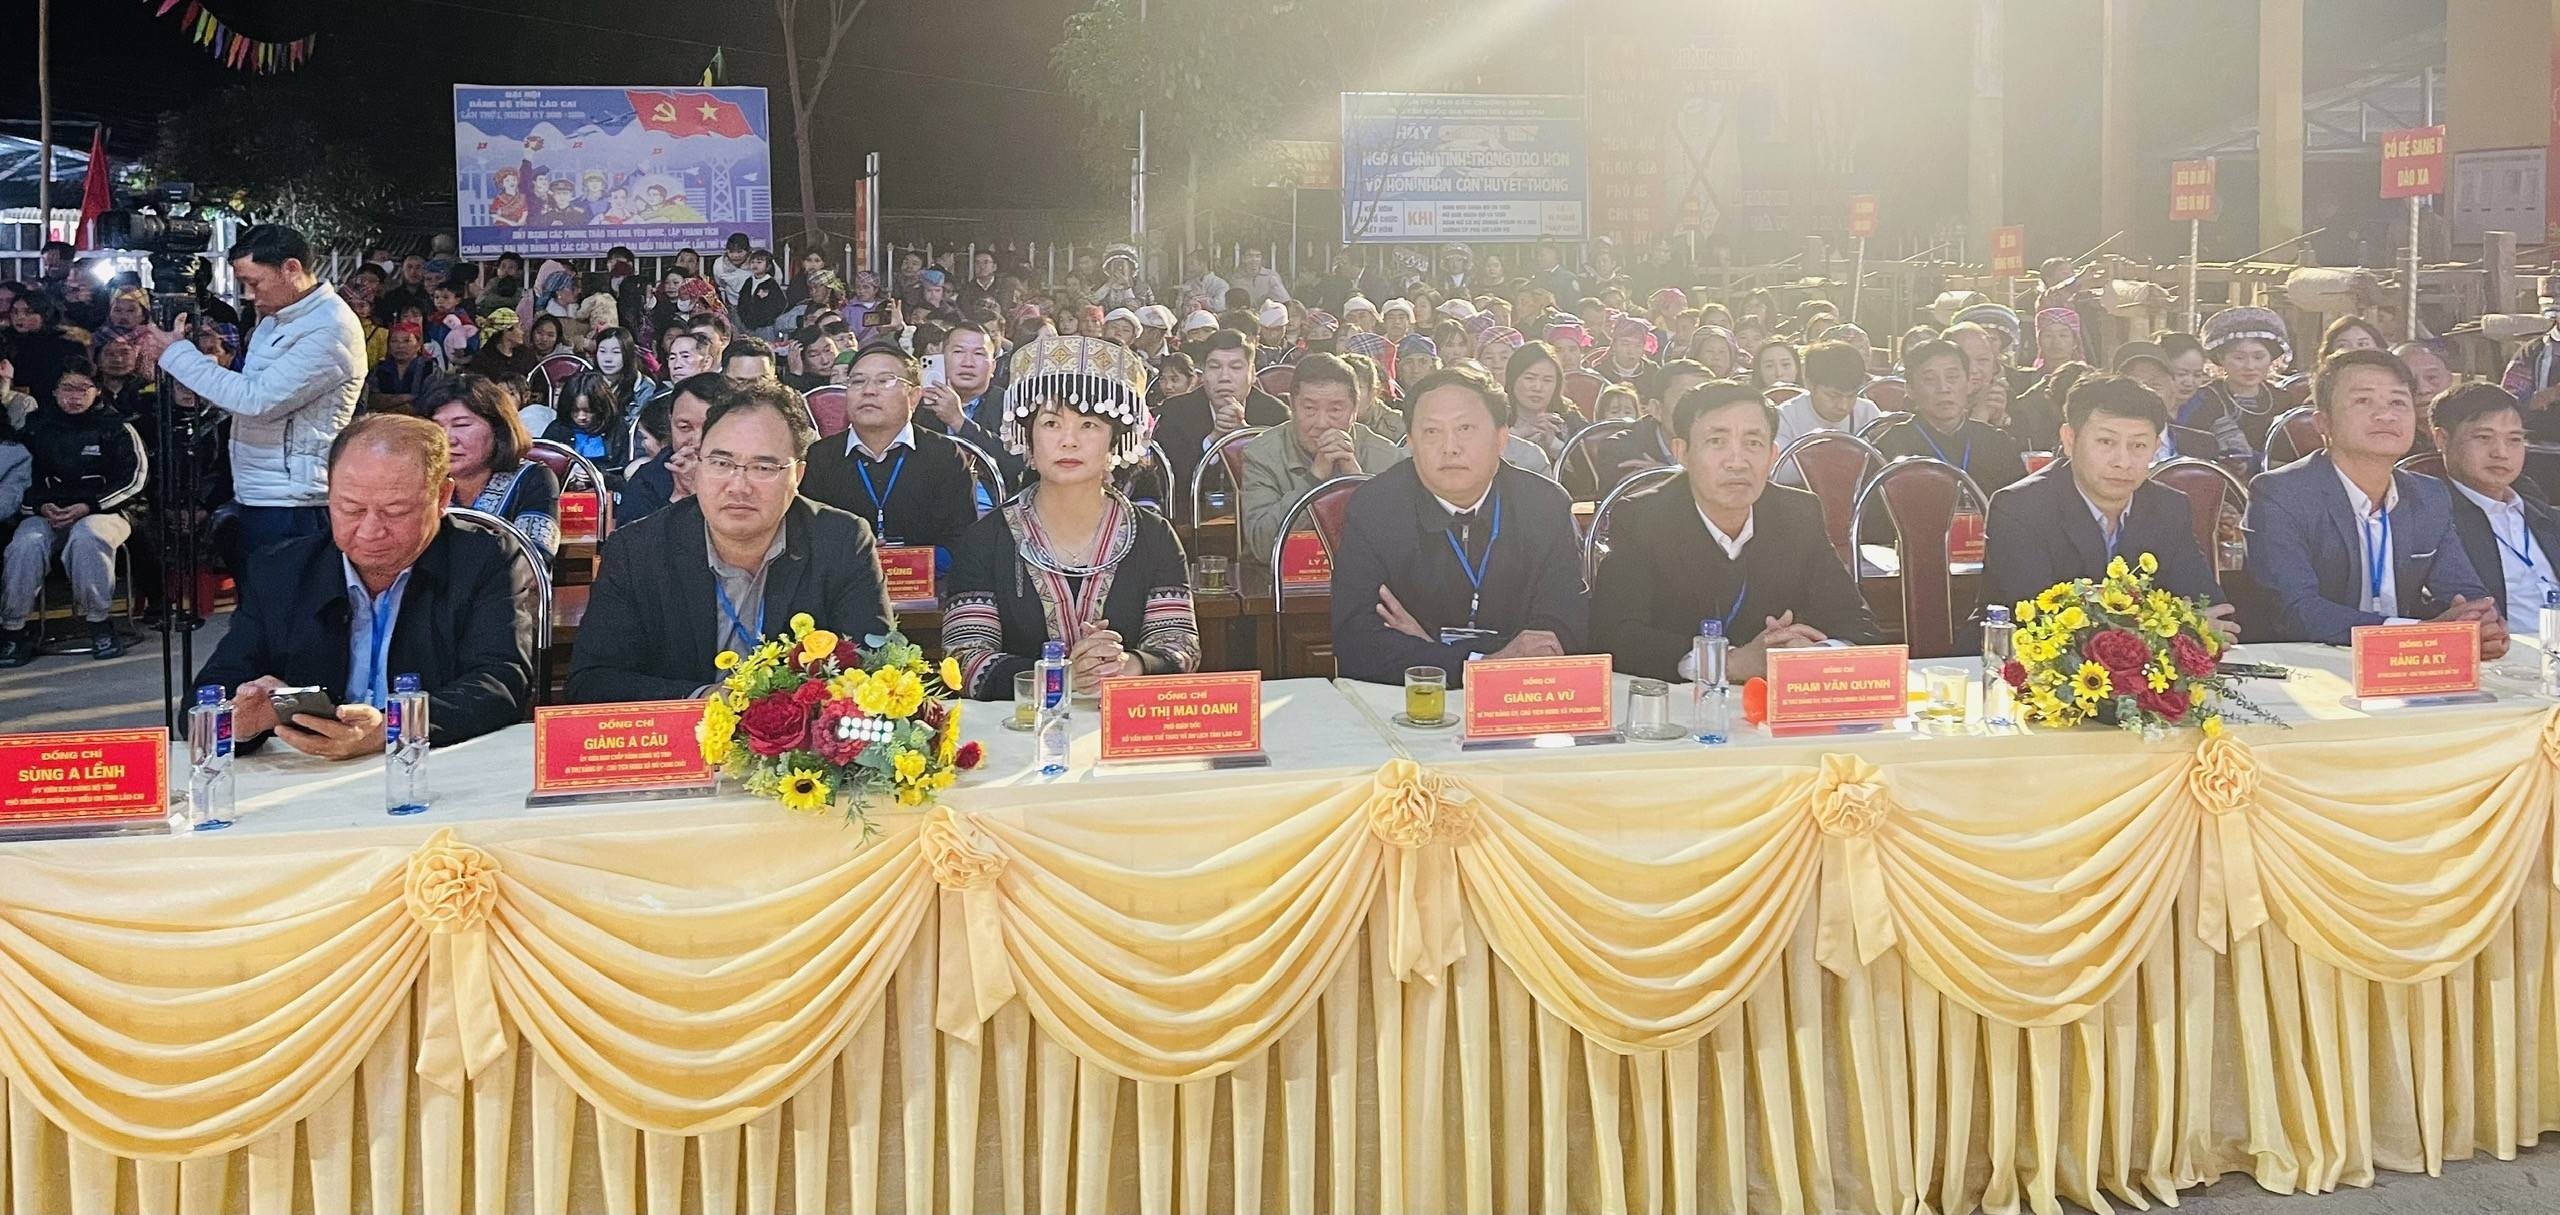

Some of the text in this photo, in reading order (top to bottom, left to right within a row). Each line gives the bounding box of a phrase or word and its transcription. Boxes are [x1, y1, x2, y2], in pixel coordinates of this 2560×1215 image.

[560, 100, 577, 108] CAI
[2411, 137, 2435, 156] SANG
[1407, 211, 1433, 226] KHI
[2422, 654, 2431, 665] A
[1787, 681, 1821, 695] PHẠM
[1823, 679, 1848, 691] VĂN
[1157, 689, 1208, 701] ĐỒNG CHÍ
[1545, 692, 1555, 703] A
[1127, 702, 1239, 721] VŨ THỊ MAI OANH
[598, 717, 655, 730] ĐỒNG CHÍ
[583, 731, 668, 750] GIÀNG A CÂU
[41, 748, 103, 761] ĐỒNG CHÍ
[18, 765, 64, 782] SÙNG
[68, 767, 80, 780] A
